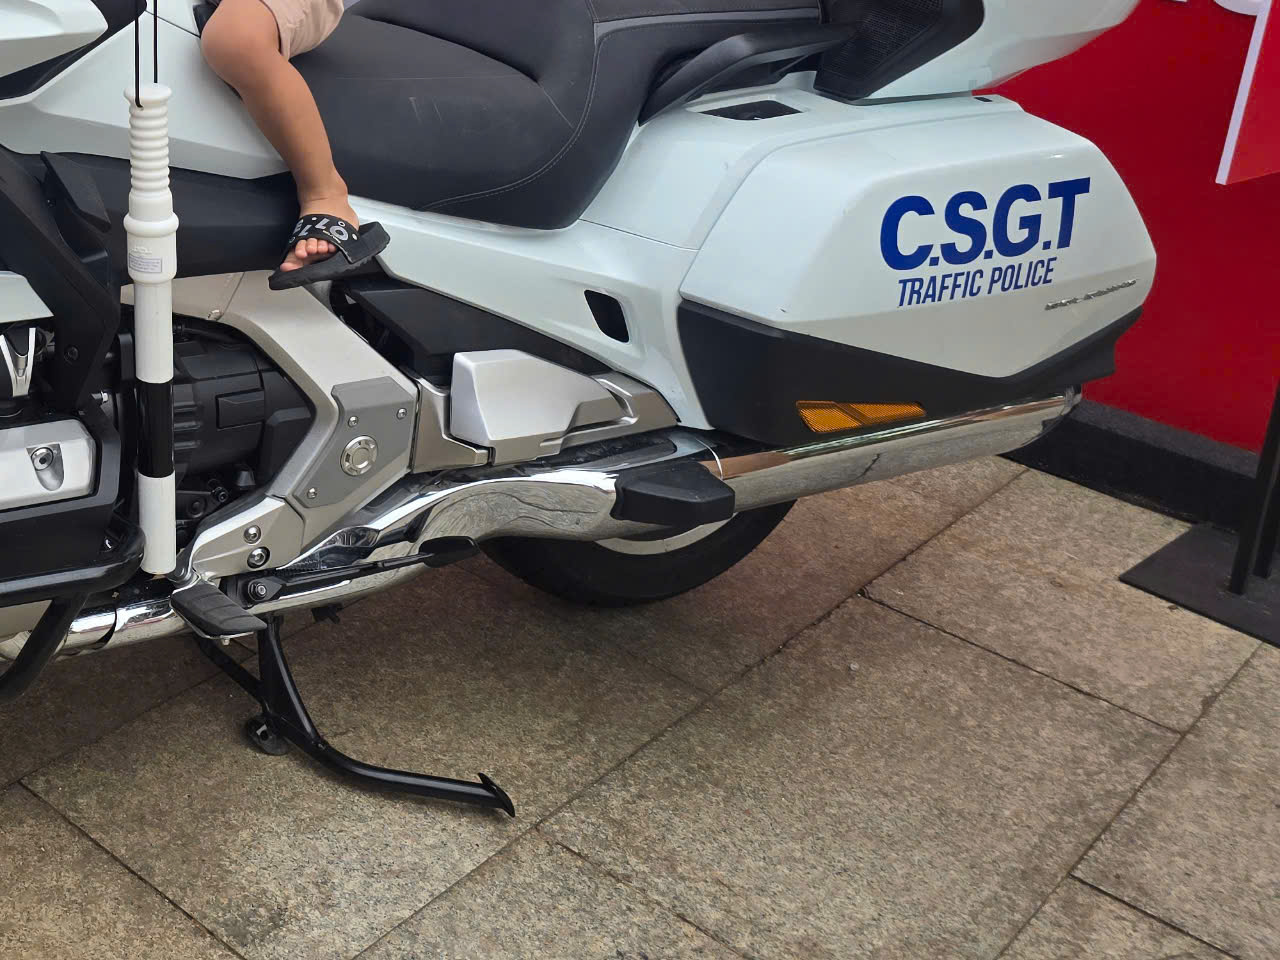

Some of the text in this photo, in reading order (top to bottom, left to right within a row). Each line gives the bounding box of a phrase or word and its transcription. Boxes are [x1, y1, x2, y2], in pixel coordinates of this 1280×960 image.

[880, 176, 1091, 271] C.S.G.T
[897, 269, 983, 307] TRAFFIC
[987, 256, 1058, 295] POLICE
